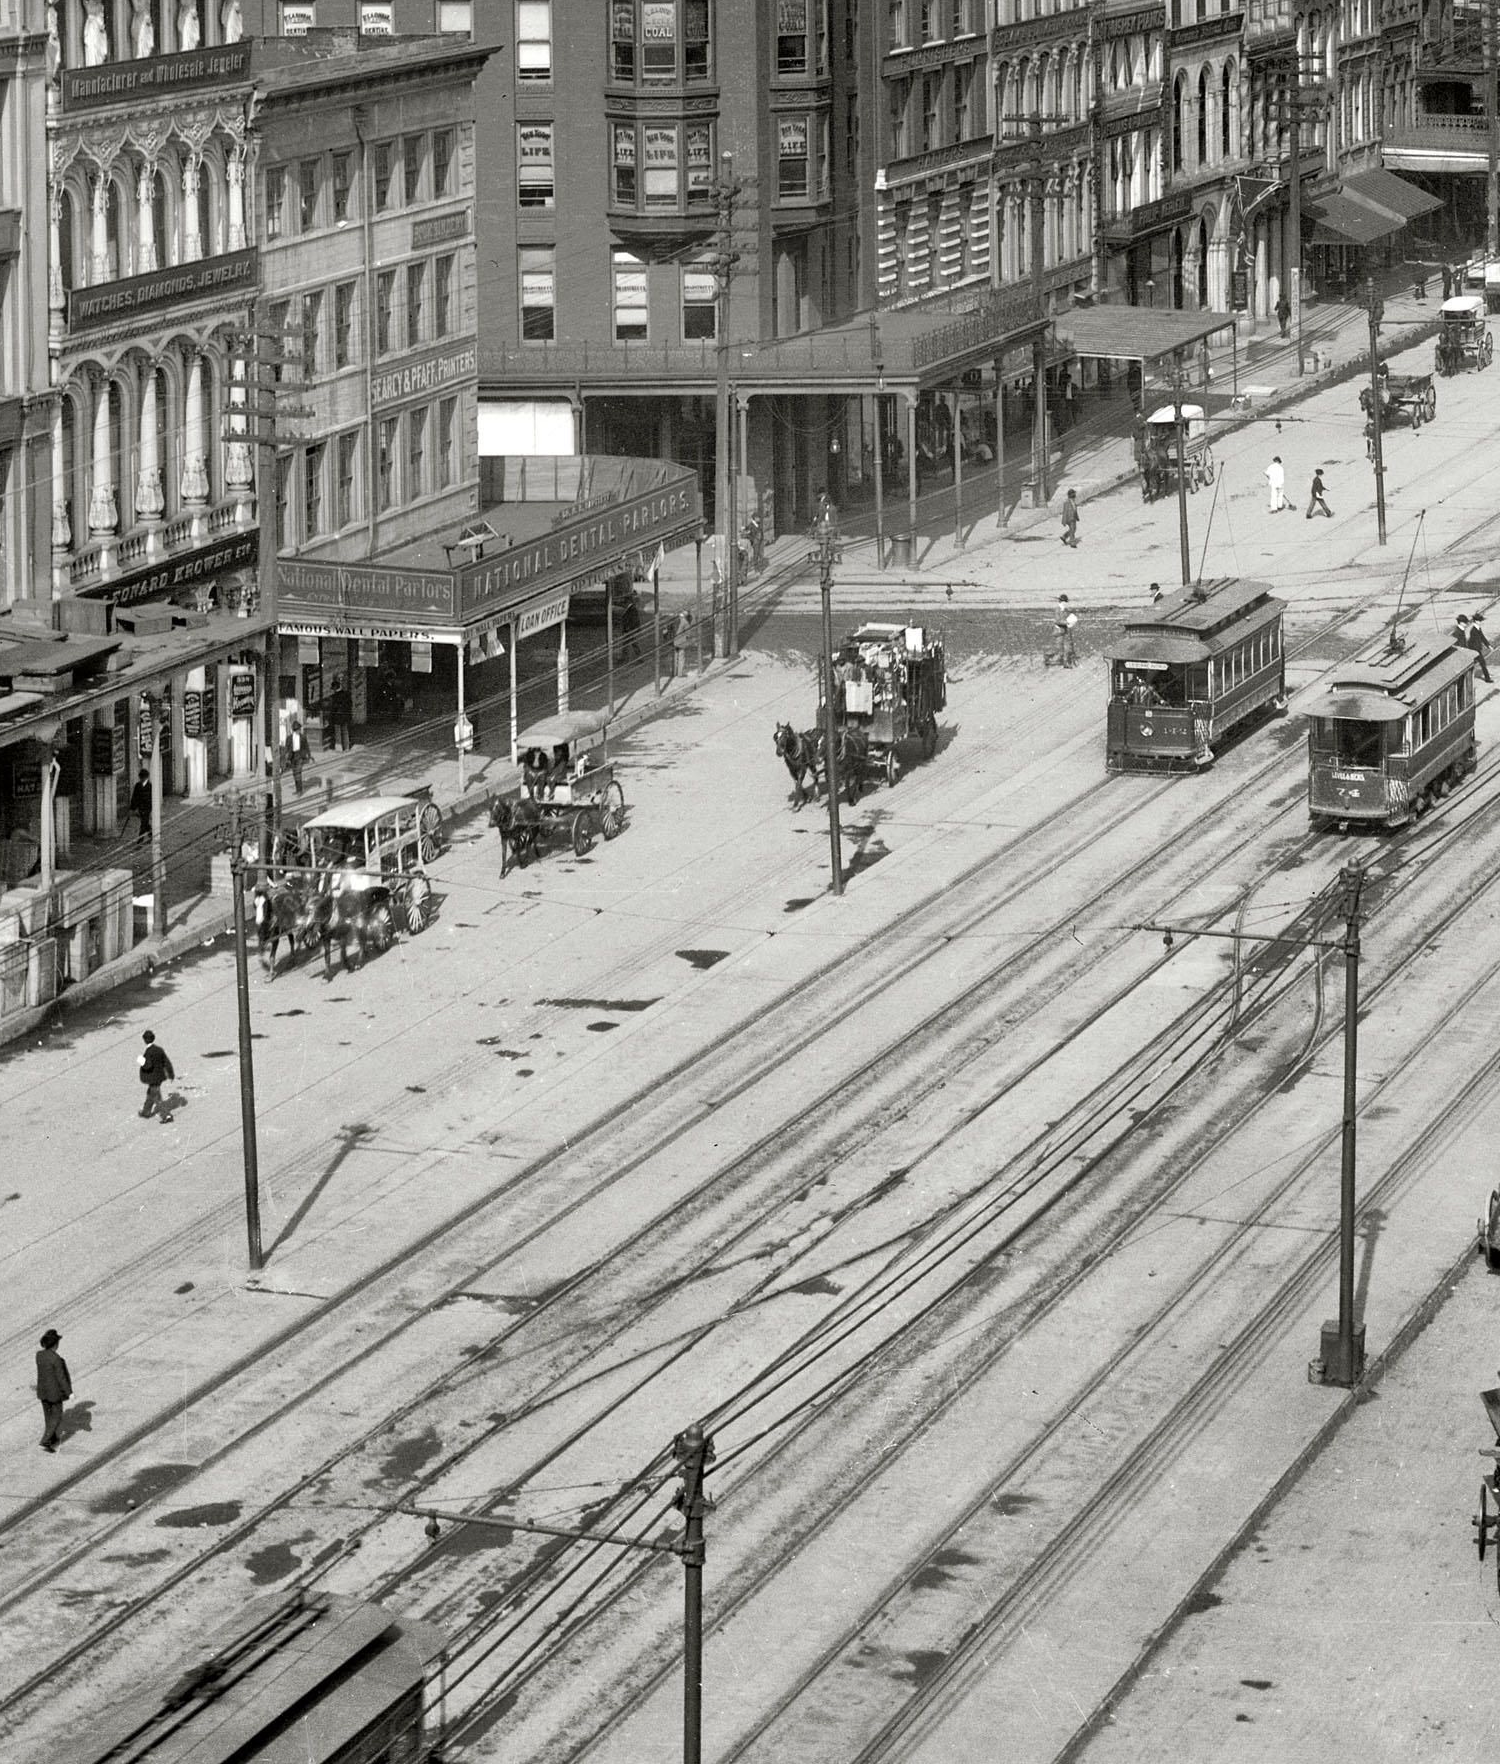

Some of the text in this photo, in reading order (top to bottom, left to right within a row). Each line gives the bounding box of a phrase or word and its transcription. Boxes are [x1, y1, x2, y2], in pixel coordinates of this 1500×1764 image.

[645, 27, 672, 37] COAL
[71, 71, 138, 98] Manufacturer
[156, 58, 204, 83] Wholesale
[206, 52, 245, 76] Jeweler
[520, 147, 551, 157] LIFE
[615, 148, 635, 157] LIFE
[646, 150, 677, 160] LIFE
[687, 147, 710, 157] LIFE
[780, 141, 807, 151] LIFE
[79, 260, 251, 317] WATCHES, DIAMONDS, JEWELRY.
[371, 374, 403, 404] SEARCY
[403, 370, 411, 393] &
[473, 547, 553, 600] NATIONAL
[559, 520, 616, 562] DENTAL
[622, 489, 690, 535] PARLORS.
[173, 548, 233, 584] KROWER
[277, 566, 451, 600] National Dental Parlors
[520, 599, 568, 633] LOAN OFFICE
[278, 622, 332, 636] FAMOUS
[334, 624, 365, 637] WALL
